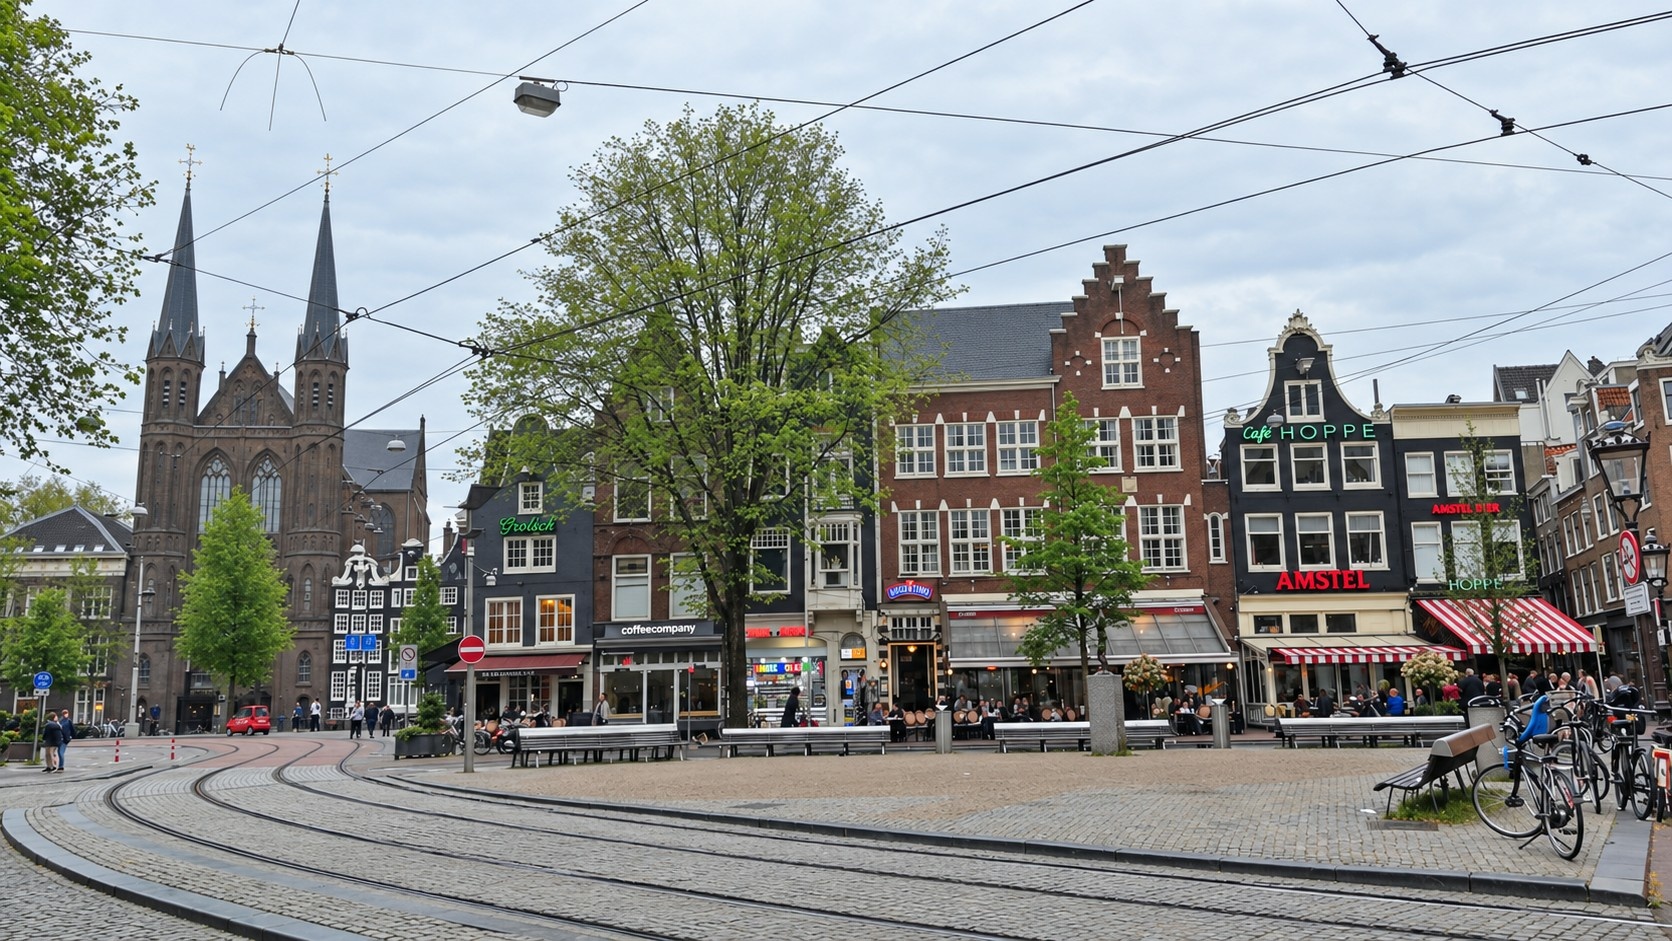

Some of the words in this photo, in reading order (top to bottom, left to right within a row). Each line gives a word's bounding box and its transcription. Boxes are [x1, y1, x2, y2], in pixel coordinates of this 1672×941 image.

[1243, 425, 1272, 443] Café
[1280, 423, 1376, 440] HOPPE
[1432, 503, 1473, 514] AMSTEL
[499, 515, 556, 535] Grolsch
[1275, 569, 1370, 590] AMSTEL
[1449, 578, 1503, 590] HOPPE
[622, 624, 696, 635] coffeecompany
